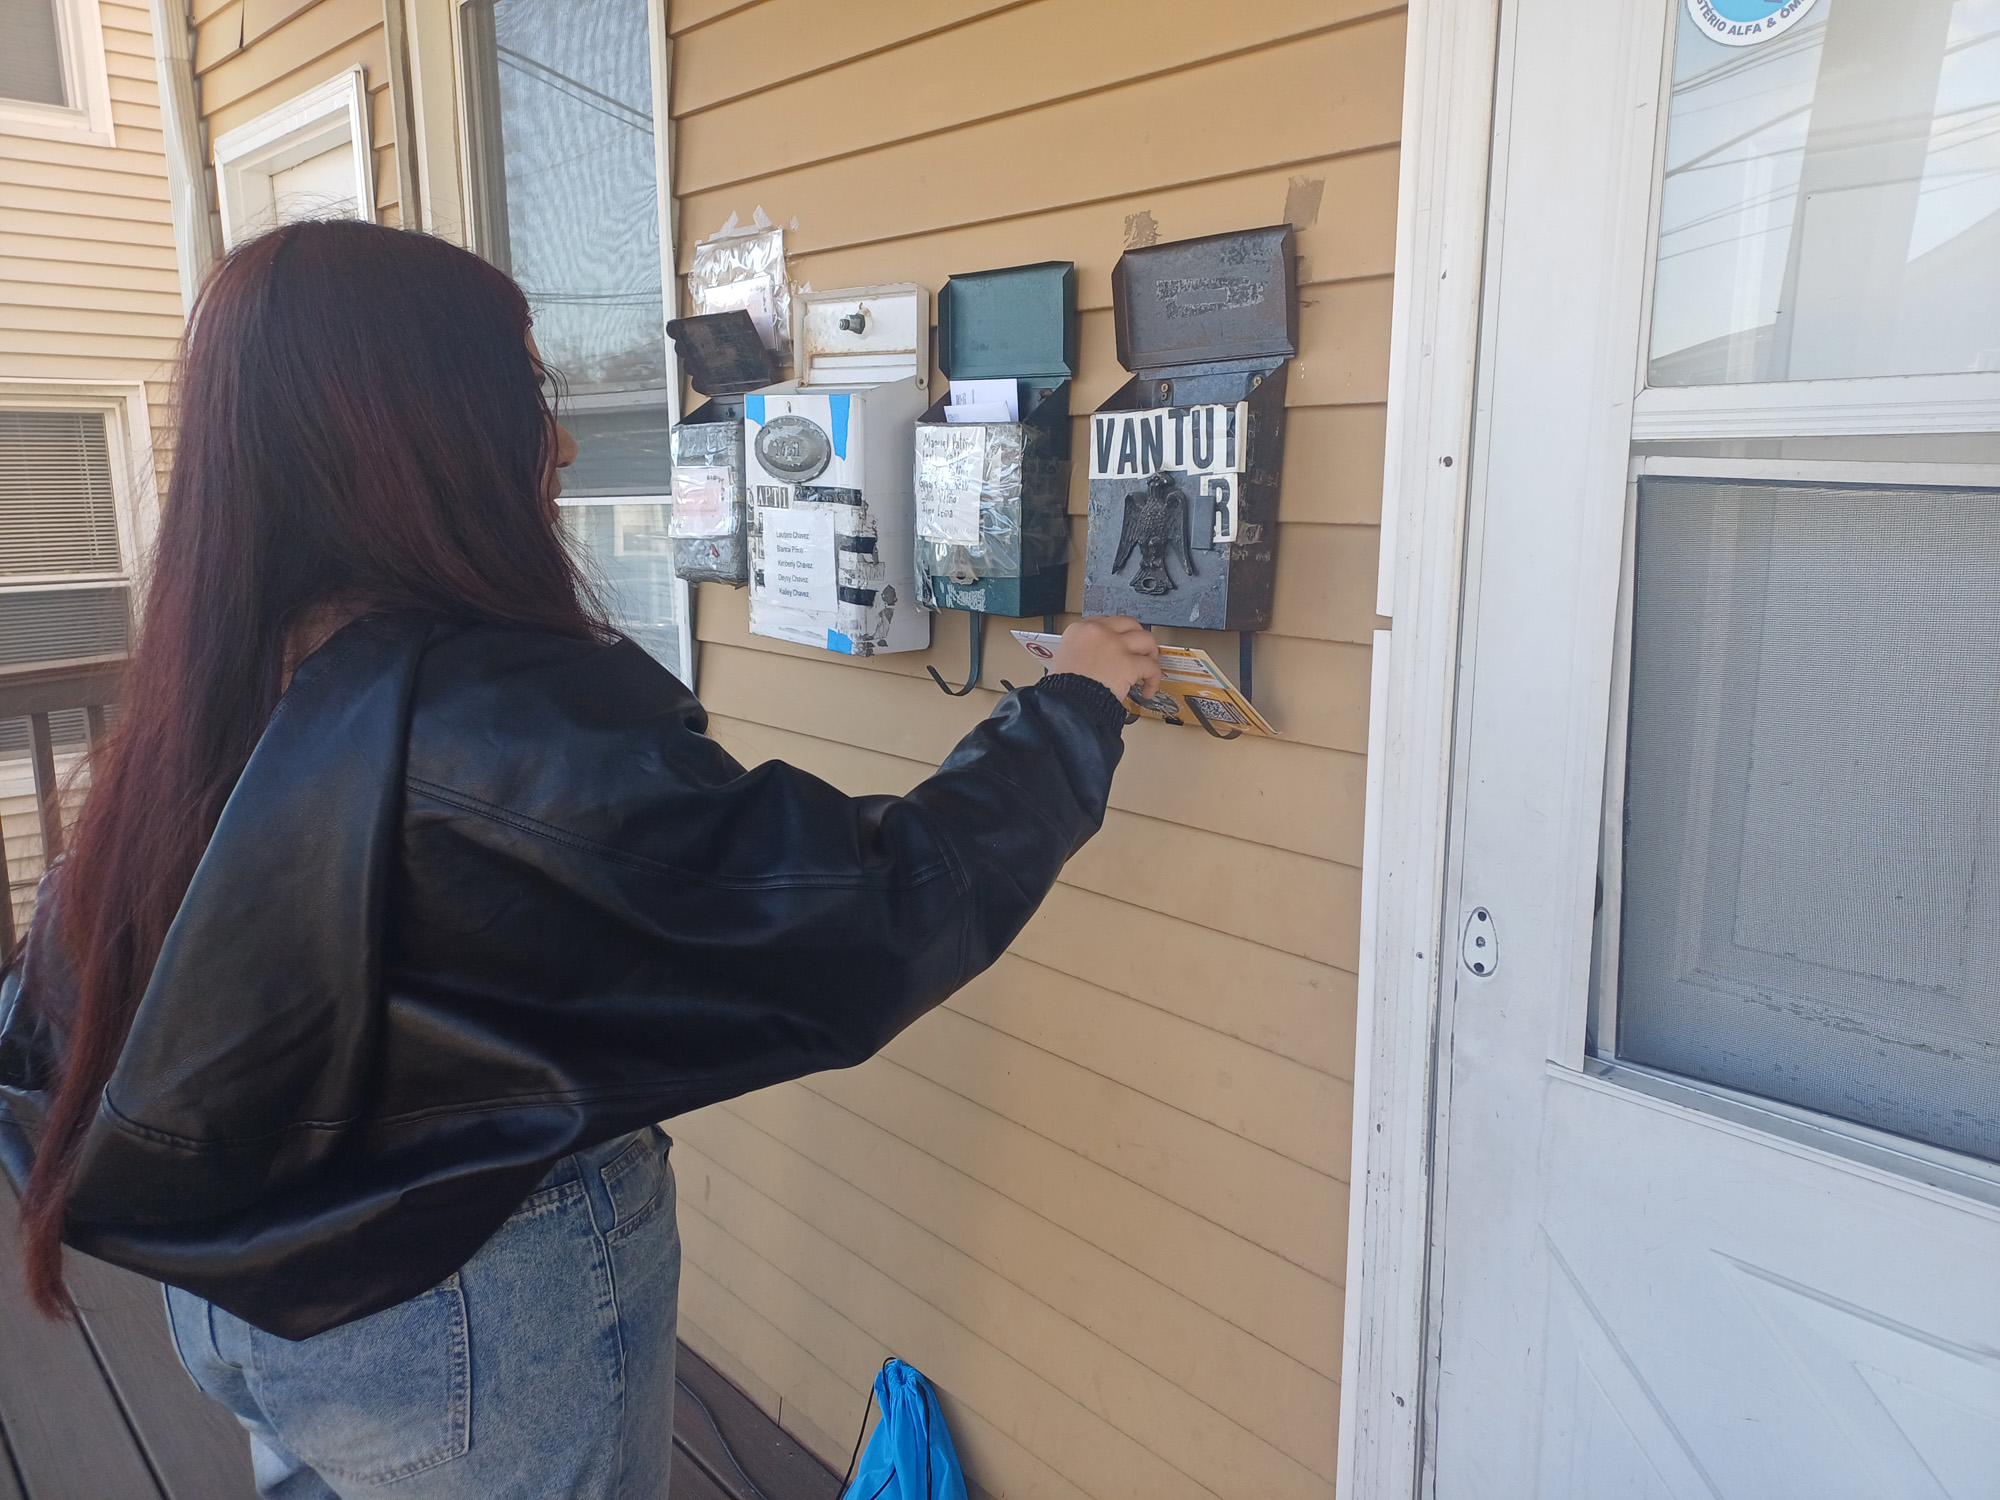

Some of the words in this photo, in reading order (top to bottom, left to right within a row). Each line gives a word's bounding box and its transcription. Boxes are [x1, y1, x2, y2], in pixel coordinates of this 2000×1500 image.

[1727, 23, 1762, 36] ALFA
[1766, 17, 1777, 28] &
[757, 486, 778, 508] APT
[1207, 478, 1231, 537] R
[793, 531, 810, 540] Chavez
[778, 559, 796, 569] Kimberly
[796, 560, 813, 569] Chavez
[792, 574, 809, 584] Chavez
[793, 588, 810, 598] Chavez
